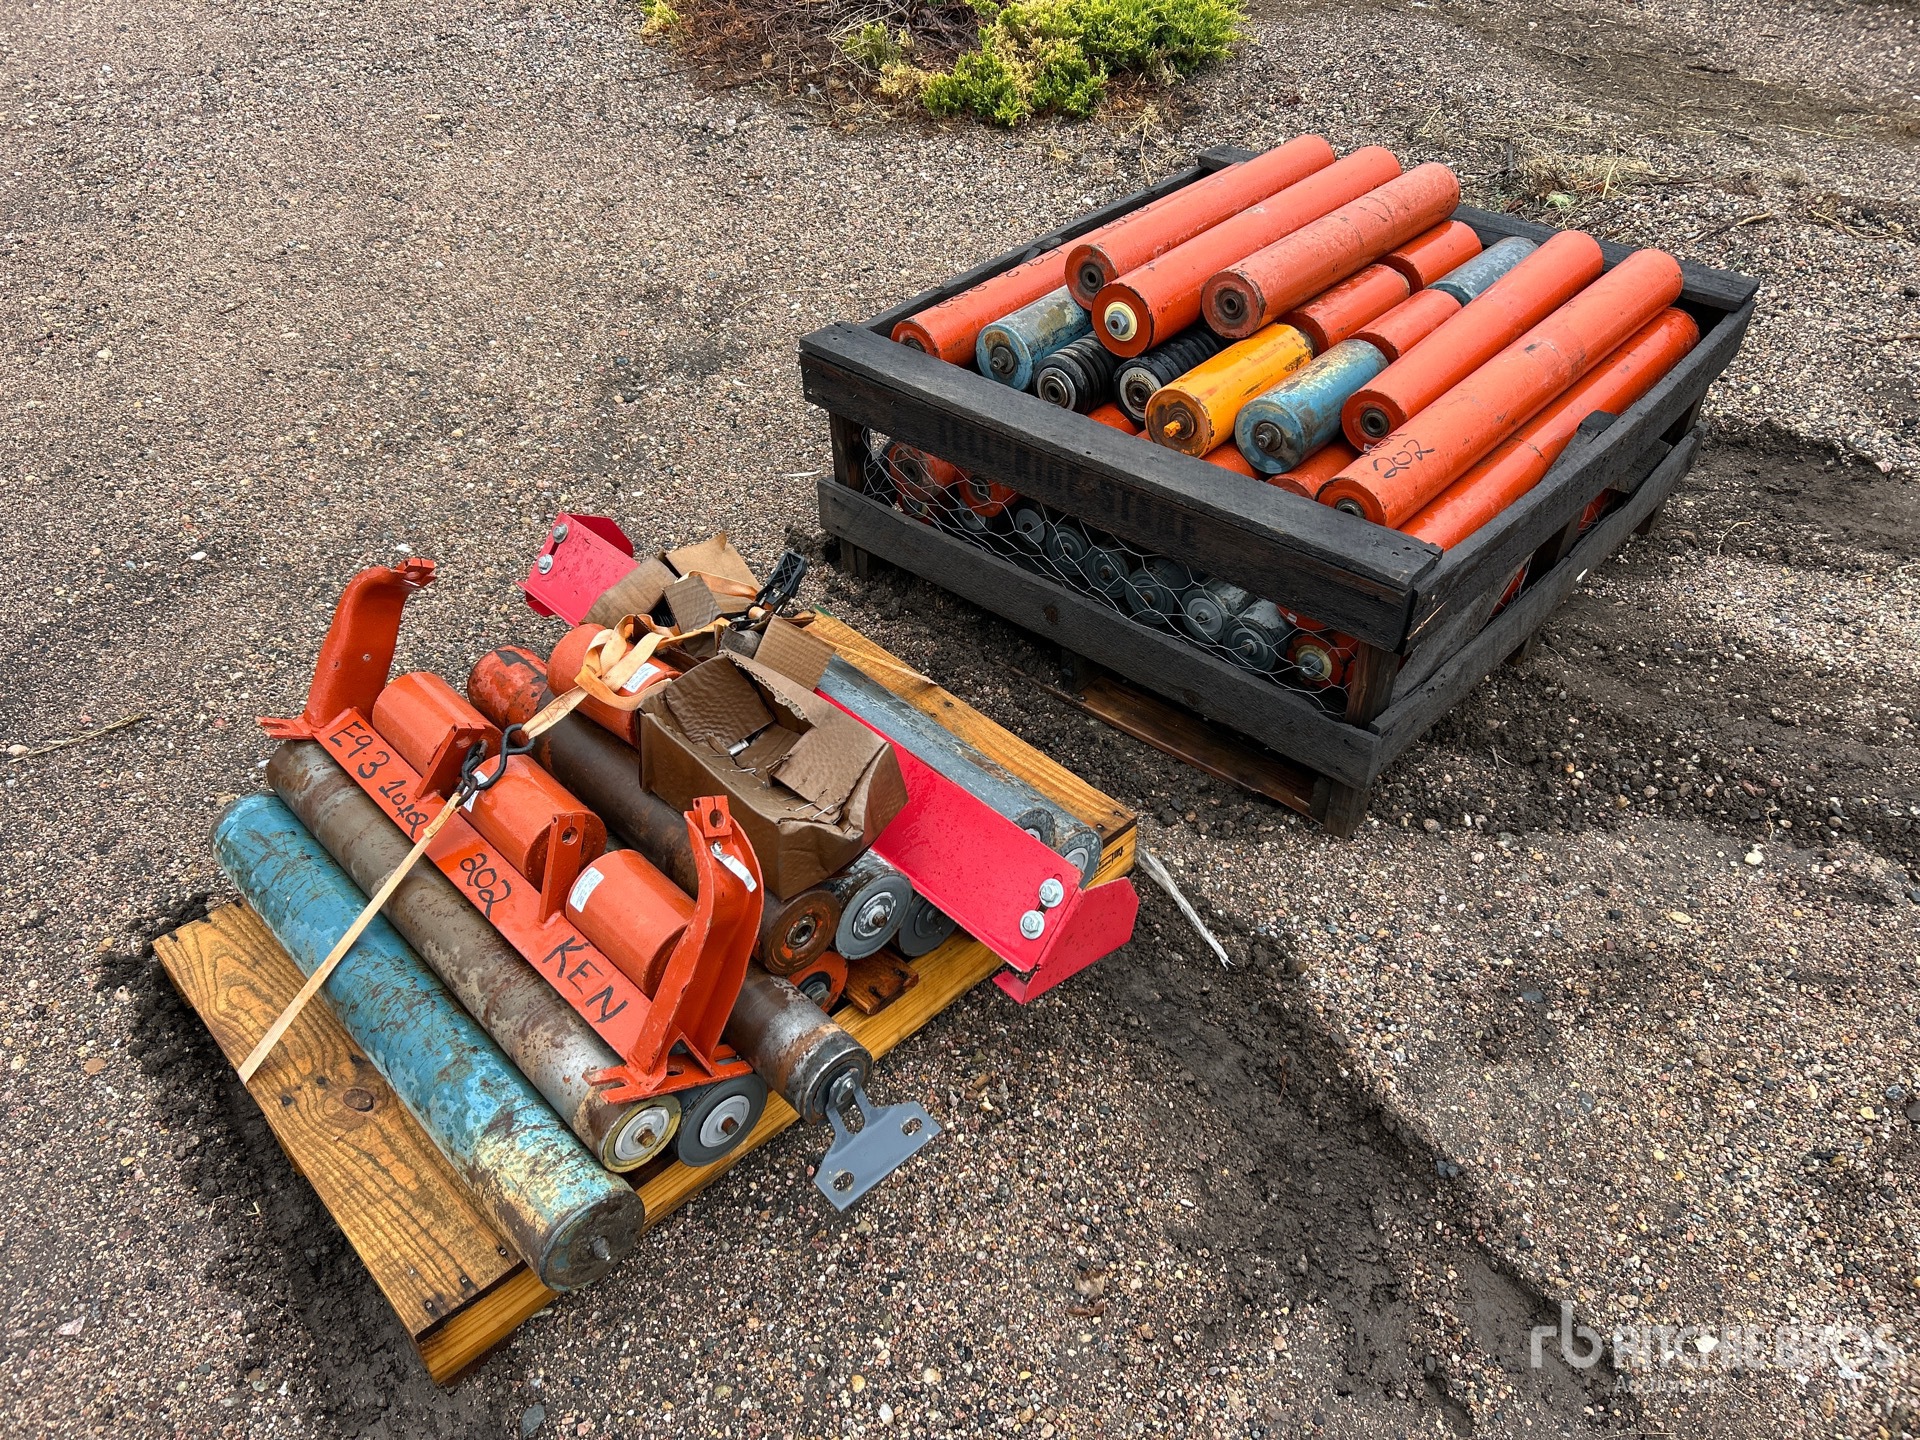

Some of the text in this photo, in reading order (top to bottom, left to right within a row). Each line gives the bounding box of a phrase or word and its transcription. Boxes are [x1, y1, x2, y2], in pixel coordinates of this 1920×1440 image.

[1373, 440, 1435, 478] 202
[460, 853, 511, 918] 202
[542, 936, 628, 1023] KEN
